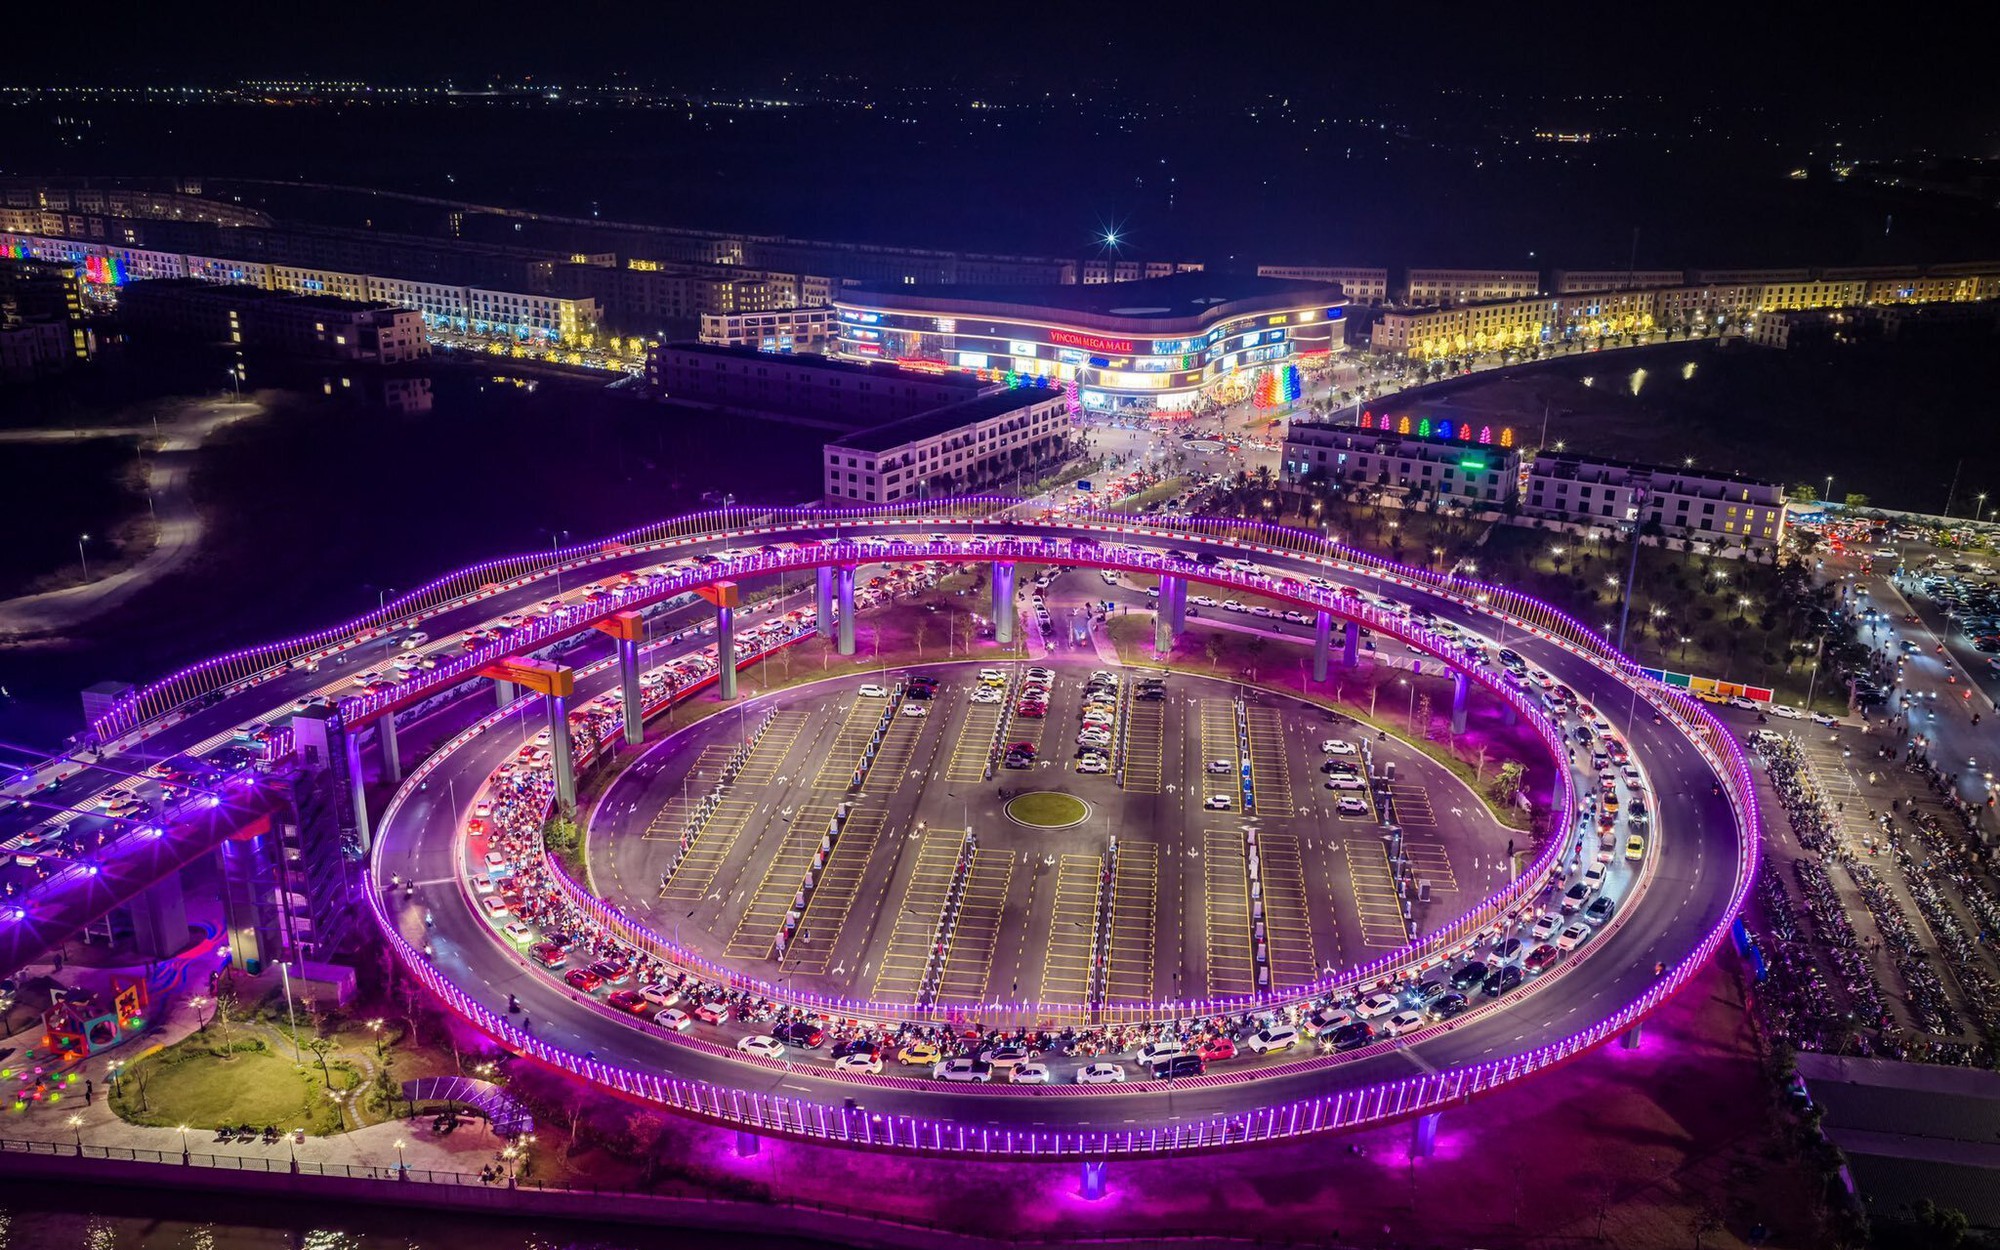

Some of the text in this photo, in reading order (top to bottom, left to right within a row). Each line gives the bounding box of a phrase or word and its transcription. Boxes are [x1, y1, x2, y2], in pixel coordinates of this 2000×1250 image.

[1050, 331, 1132, 352] VINCOM MEGA MALL
